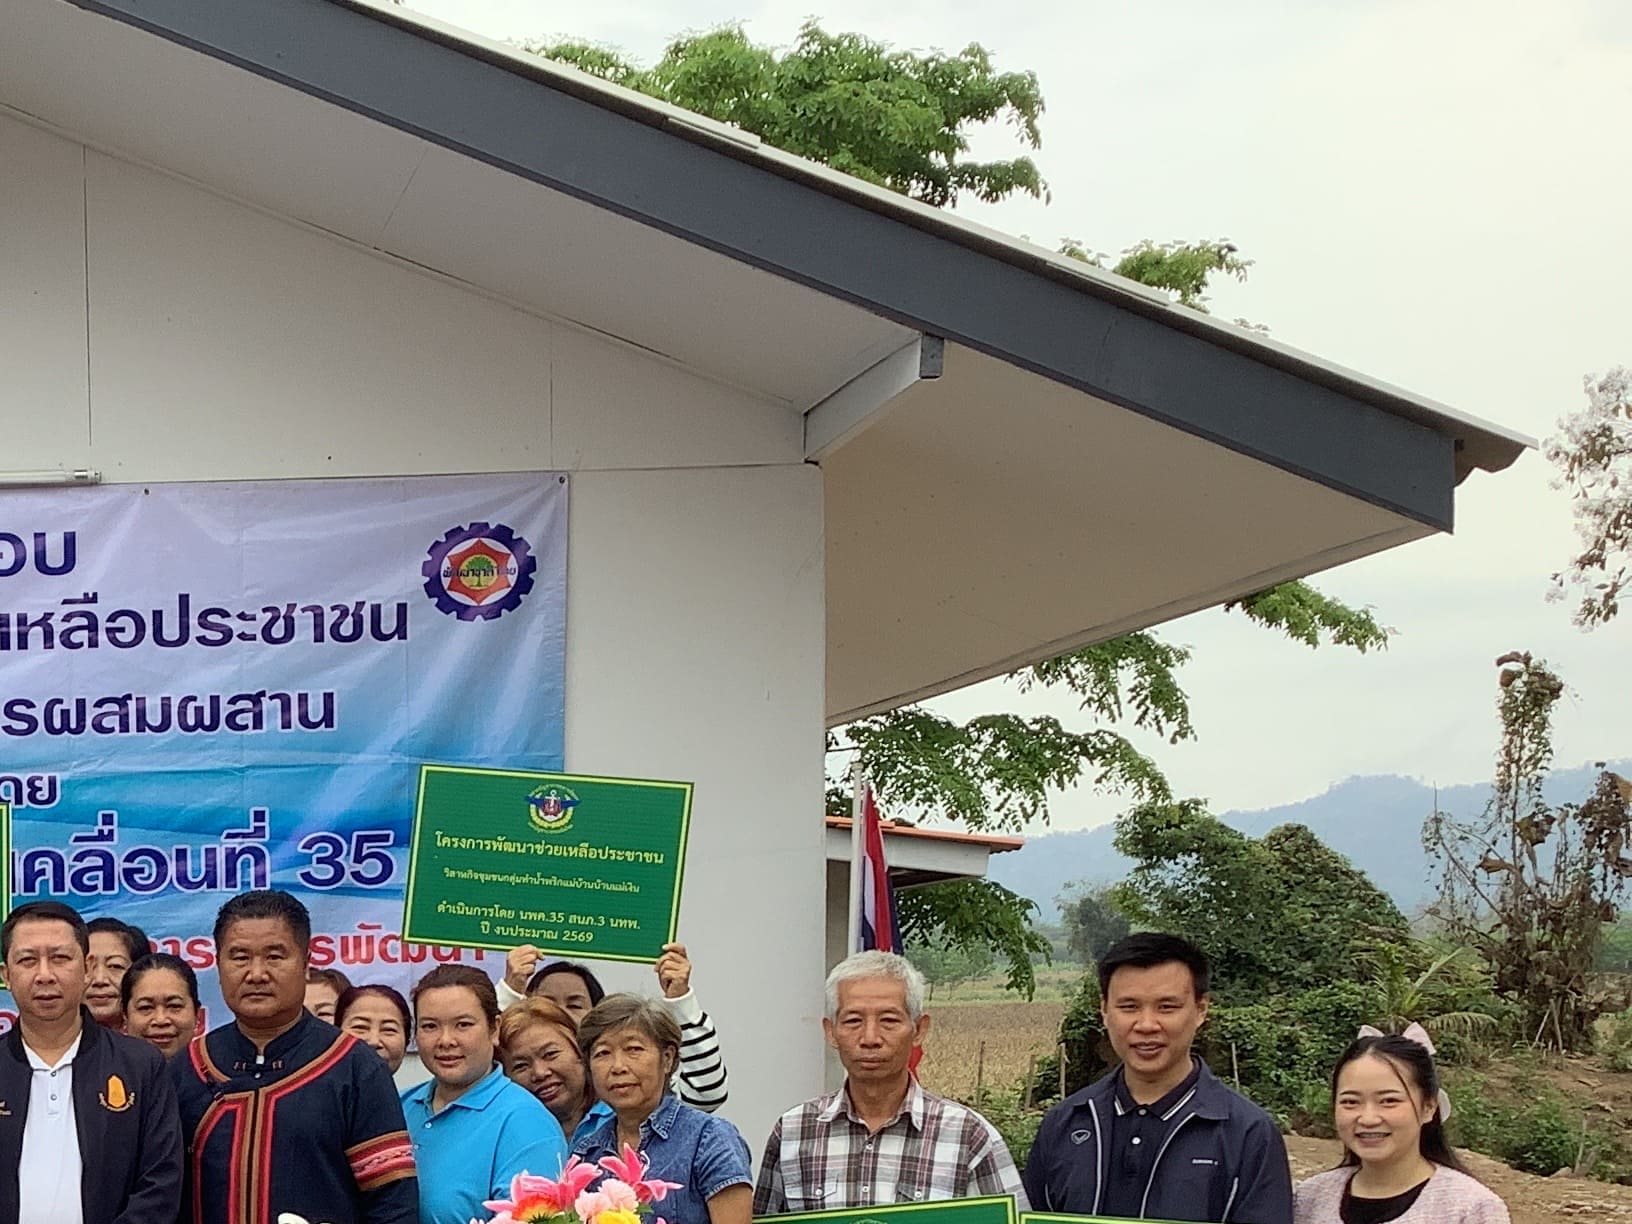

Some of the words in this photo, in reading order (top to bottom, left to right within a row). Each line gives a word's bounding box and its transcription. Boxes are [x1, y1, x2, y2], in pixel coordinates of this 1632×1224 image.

[298, 832, 395, 889] 35
[435, 831, 665, 865] โครงการพัฒนาช่วยเหลือประชาชน
[437, 900, 515, 919] ดำเนินการโดย
[519, 911, 565, 924] นพค.35
[568, 914, 606, 927] สนภ.3
[610, 916, 641, 930] นทพ.
[494, 924, 558, 941] งบประมาณ
[562, 929, 594, 943] 2569
